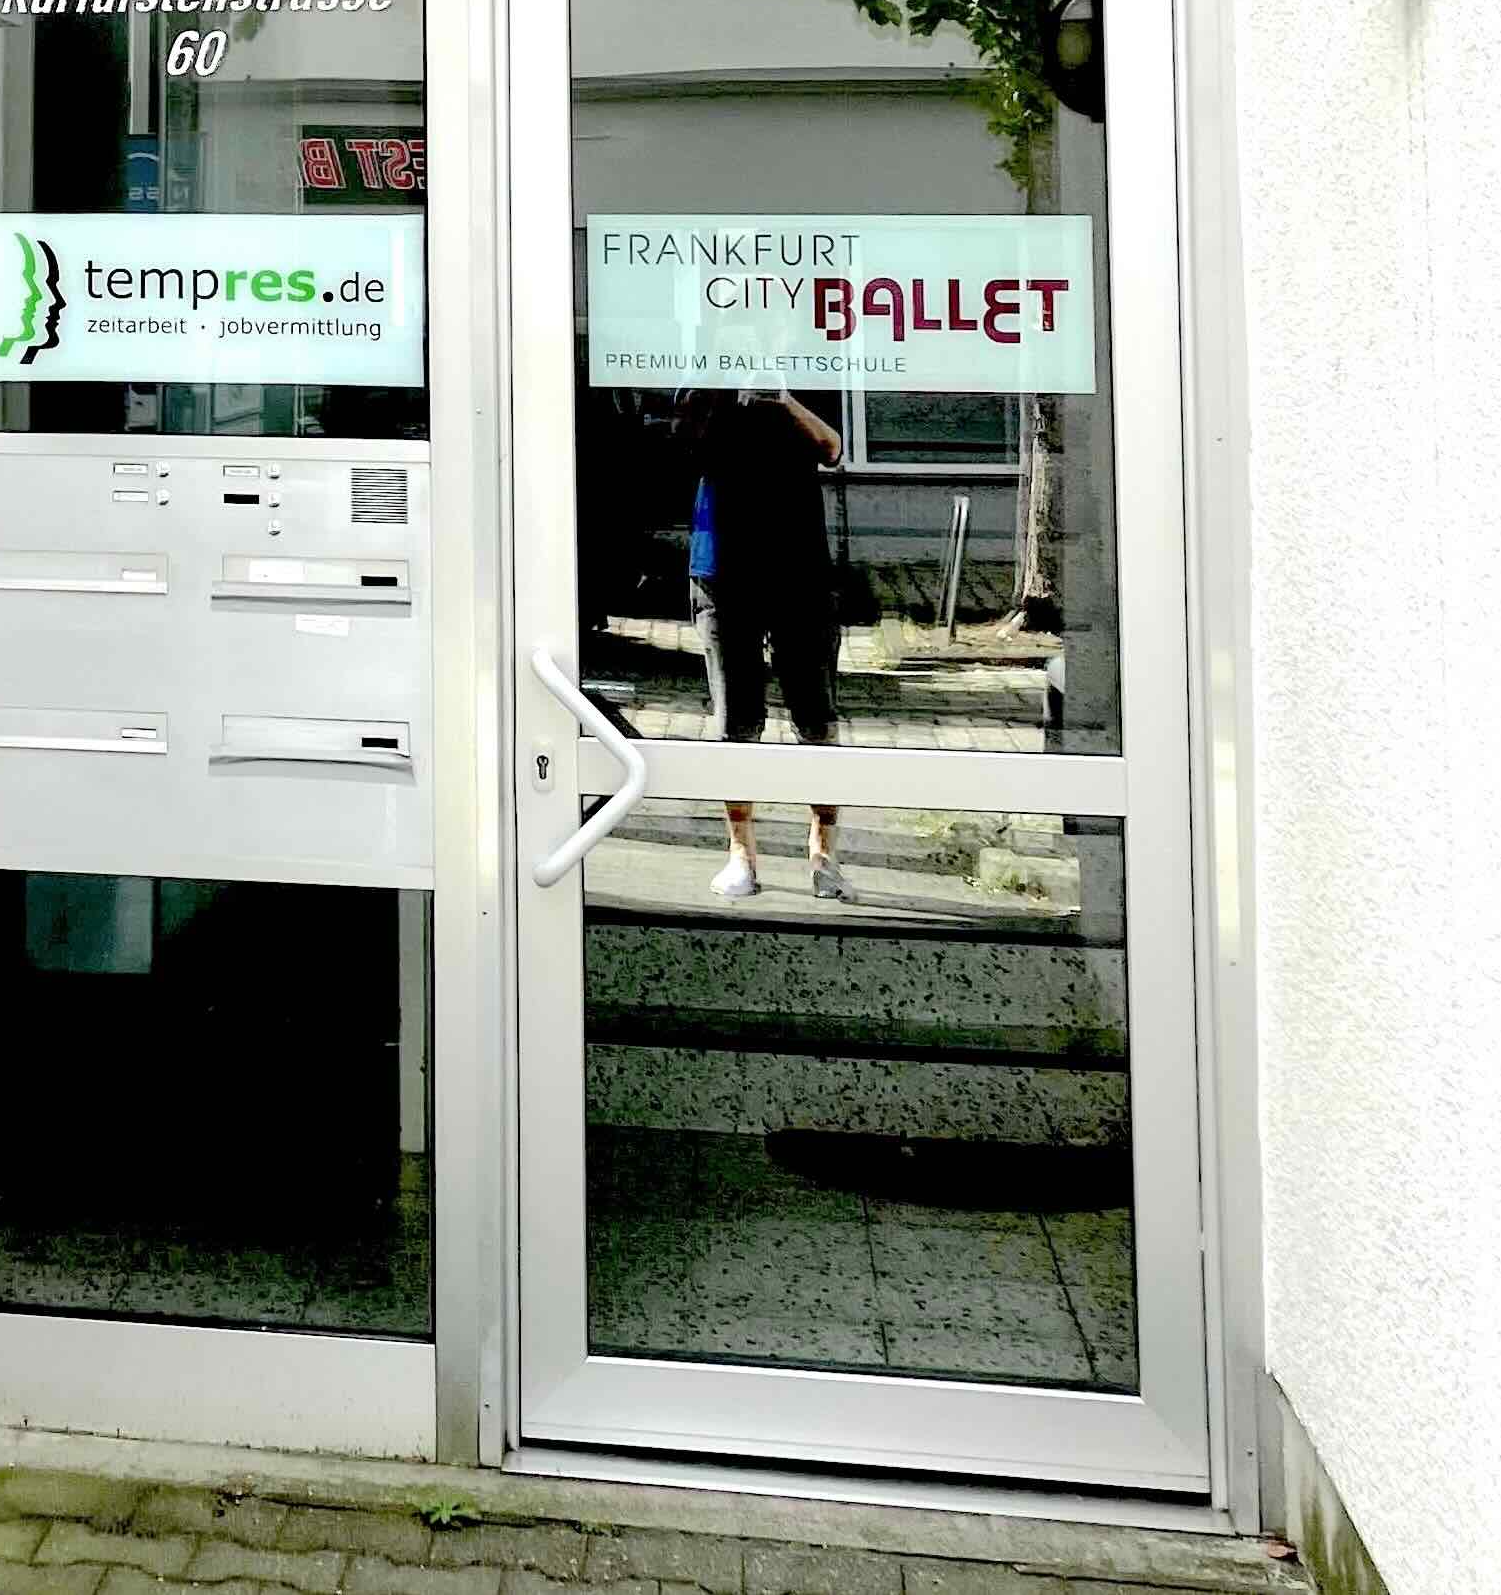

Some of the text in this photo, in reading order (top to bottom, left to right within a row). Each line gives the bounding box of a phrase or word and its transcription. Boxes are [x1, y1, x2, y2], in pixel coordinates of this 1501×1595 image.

[166, 30, 228, 77] 60
[603, 234, 861, 267] FRANKFURT
[85, 260, 386, 311] tempres.de
[87, 316, 383, 343] zeitarbeit jobvermittlung
[605, 354, 908, 374] PREMIUM BALLETTSCHULE
